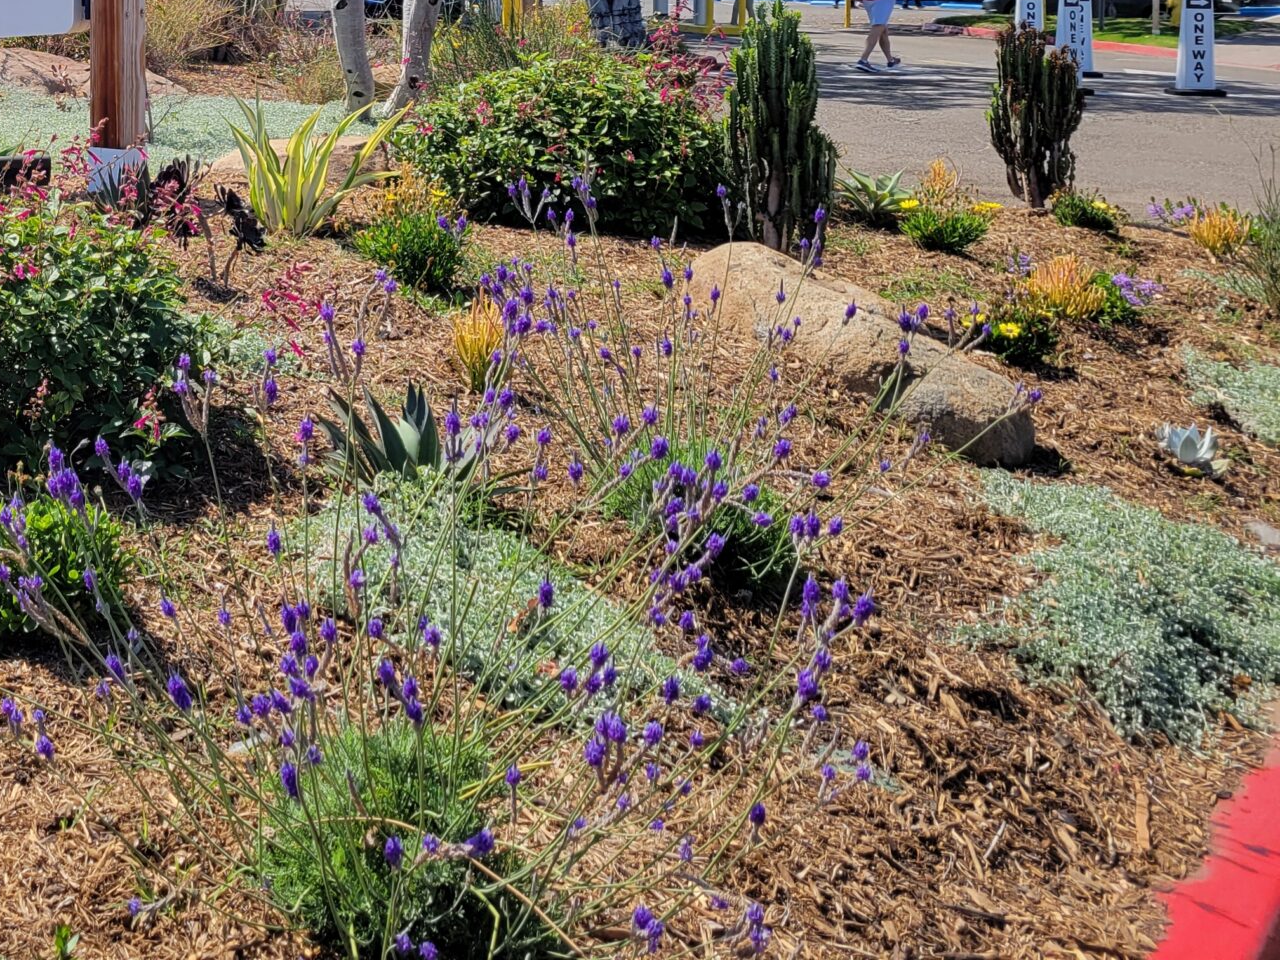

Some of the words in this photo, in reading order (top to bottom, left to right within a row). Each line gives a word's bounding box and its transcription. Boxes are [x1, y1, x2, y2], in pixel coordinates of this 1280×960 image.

[1069, 10, 1077, 44] ONE
[1193, 12, 1205, 46] ONE
[1192, 49, 1206, 83] WAY
